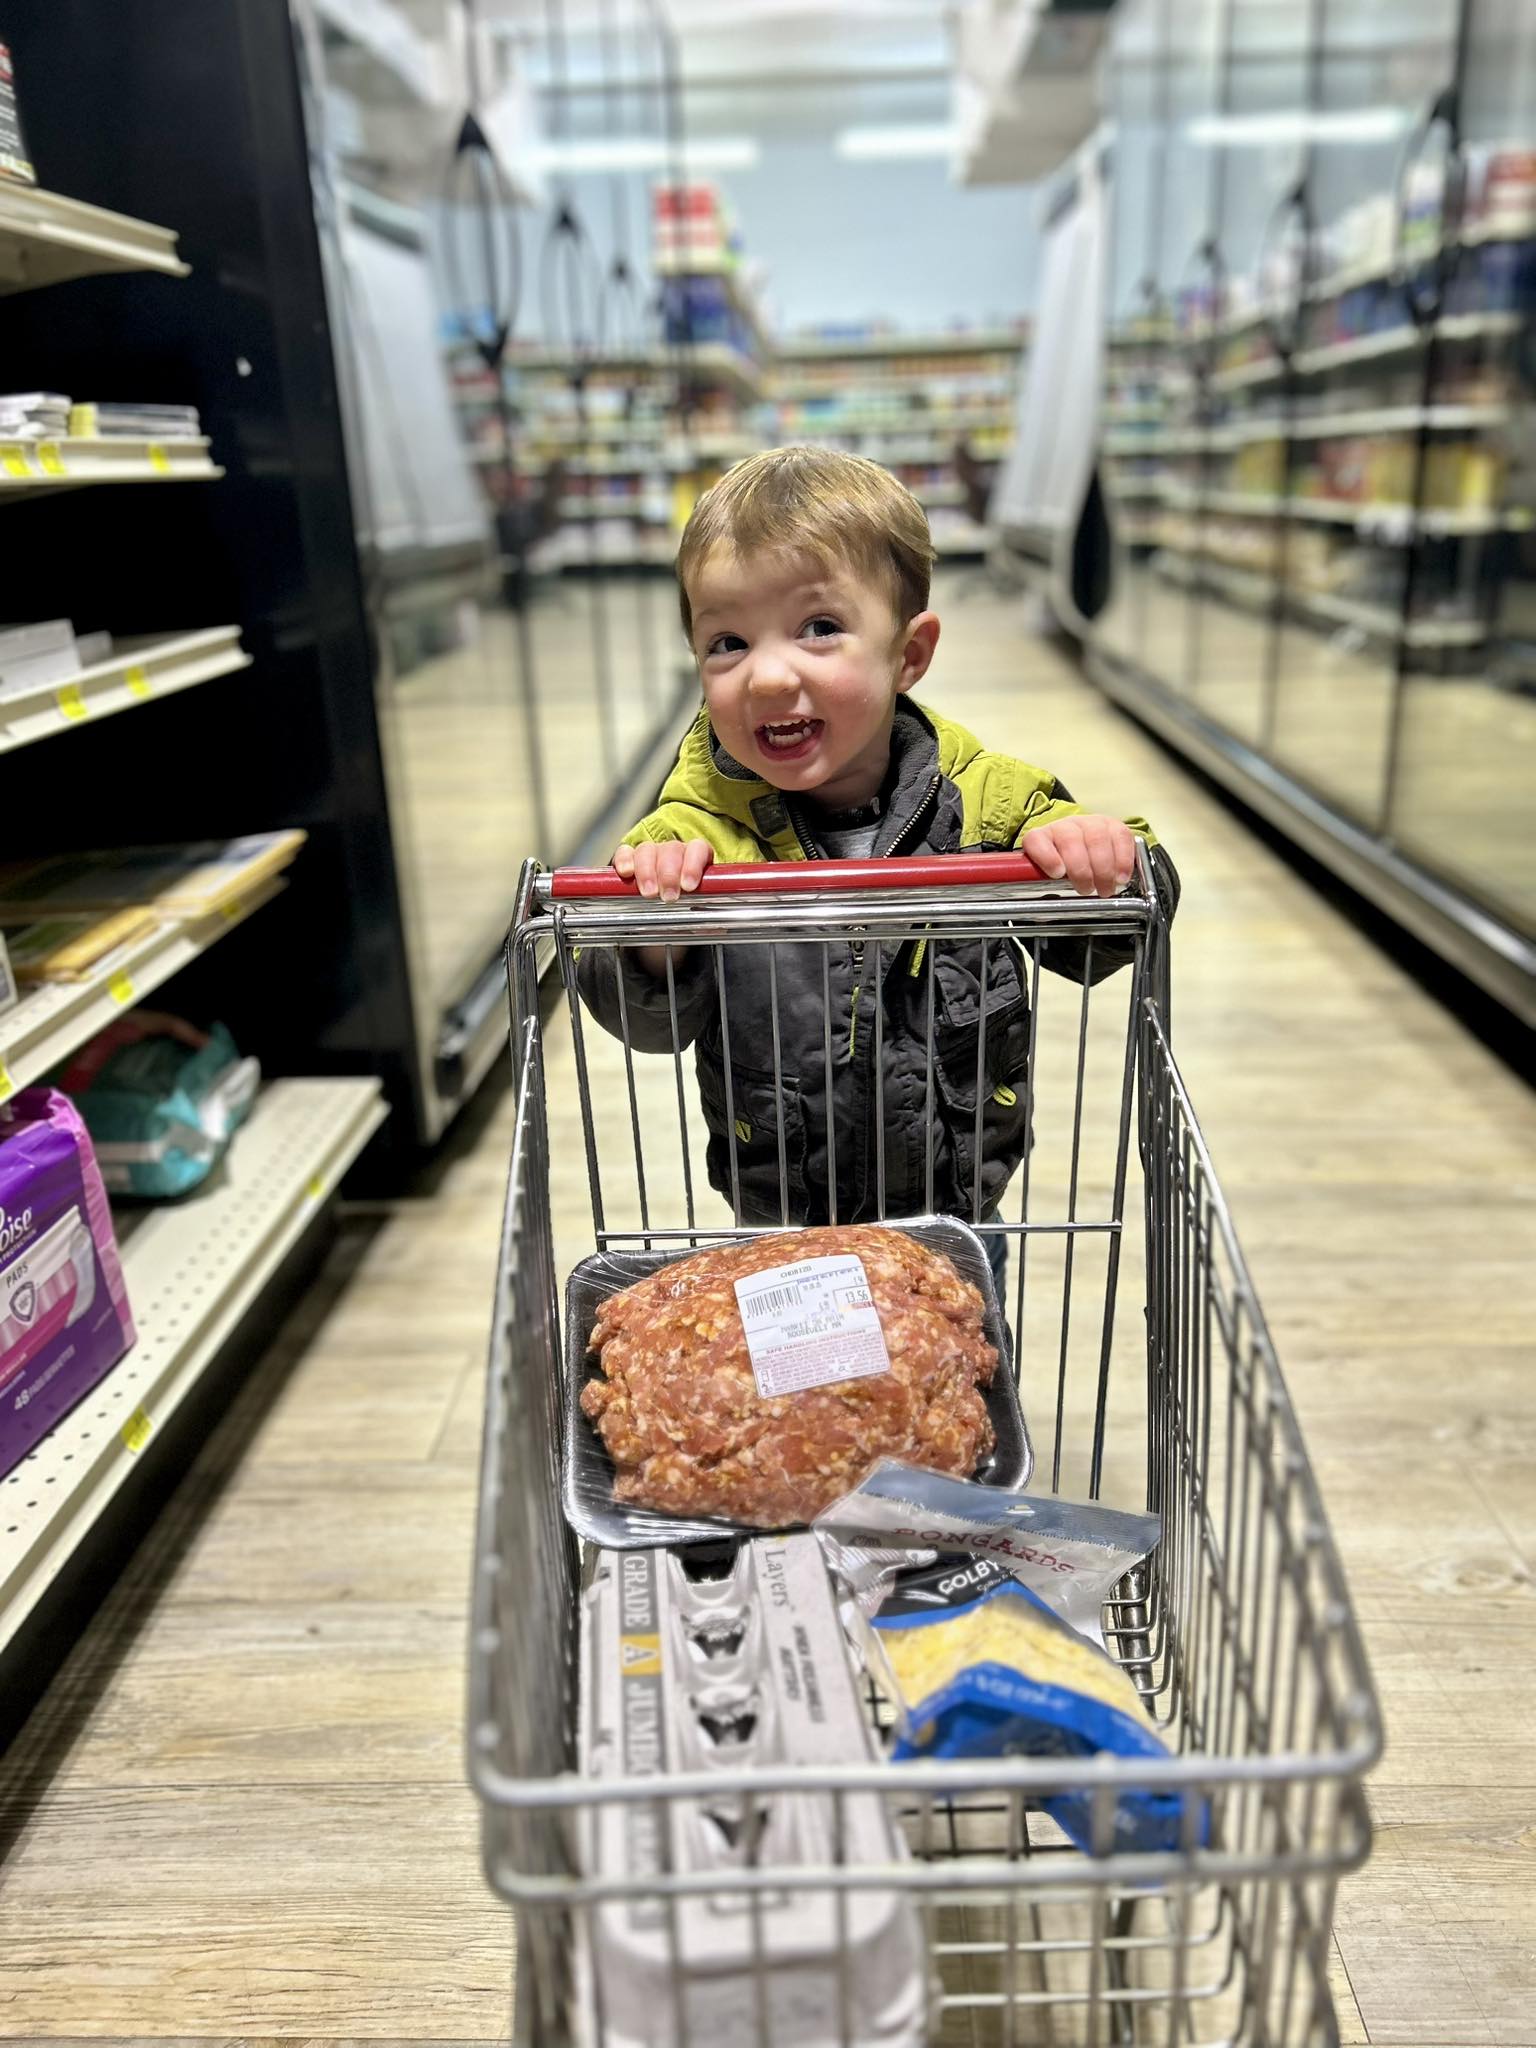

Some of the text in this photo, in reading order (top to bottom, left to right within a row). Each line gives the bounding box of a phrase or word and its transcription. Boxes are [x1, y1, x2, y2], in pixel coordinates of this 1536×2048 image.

[0, 1206, 32, 1251] oise
[6, 1261, 29, 1289] PADS
[780, 1265, 812, 1278] CHORIZO
[845, 1289, 869, 1304] 13.56
[622, 1555, 650, 1628] GRADE
[762, 1549, 789, 1607] Layers
[937, 1559, 1000, 1595] COLBY
[623, 1642, 656, 1667] A
